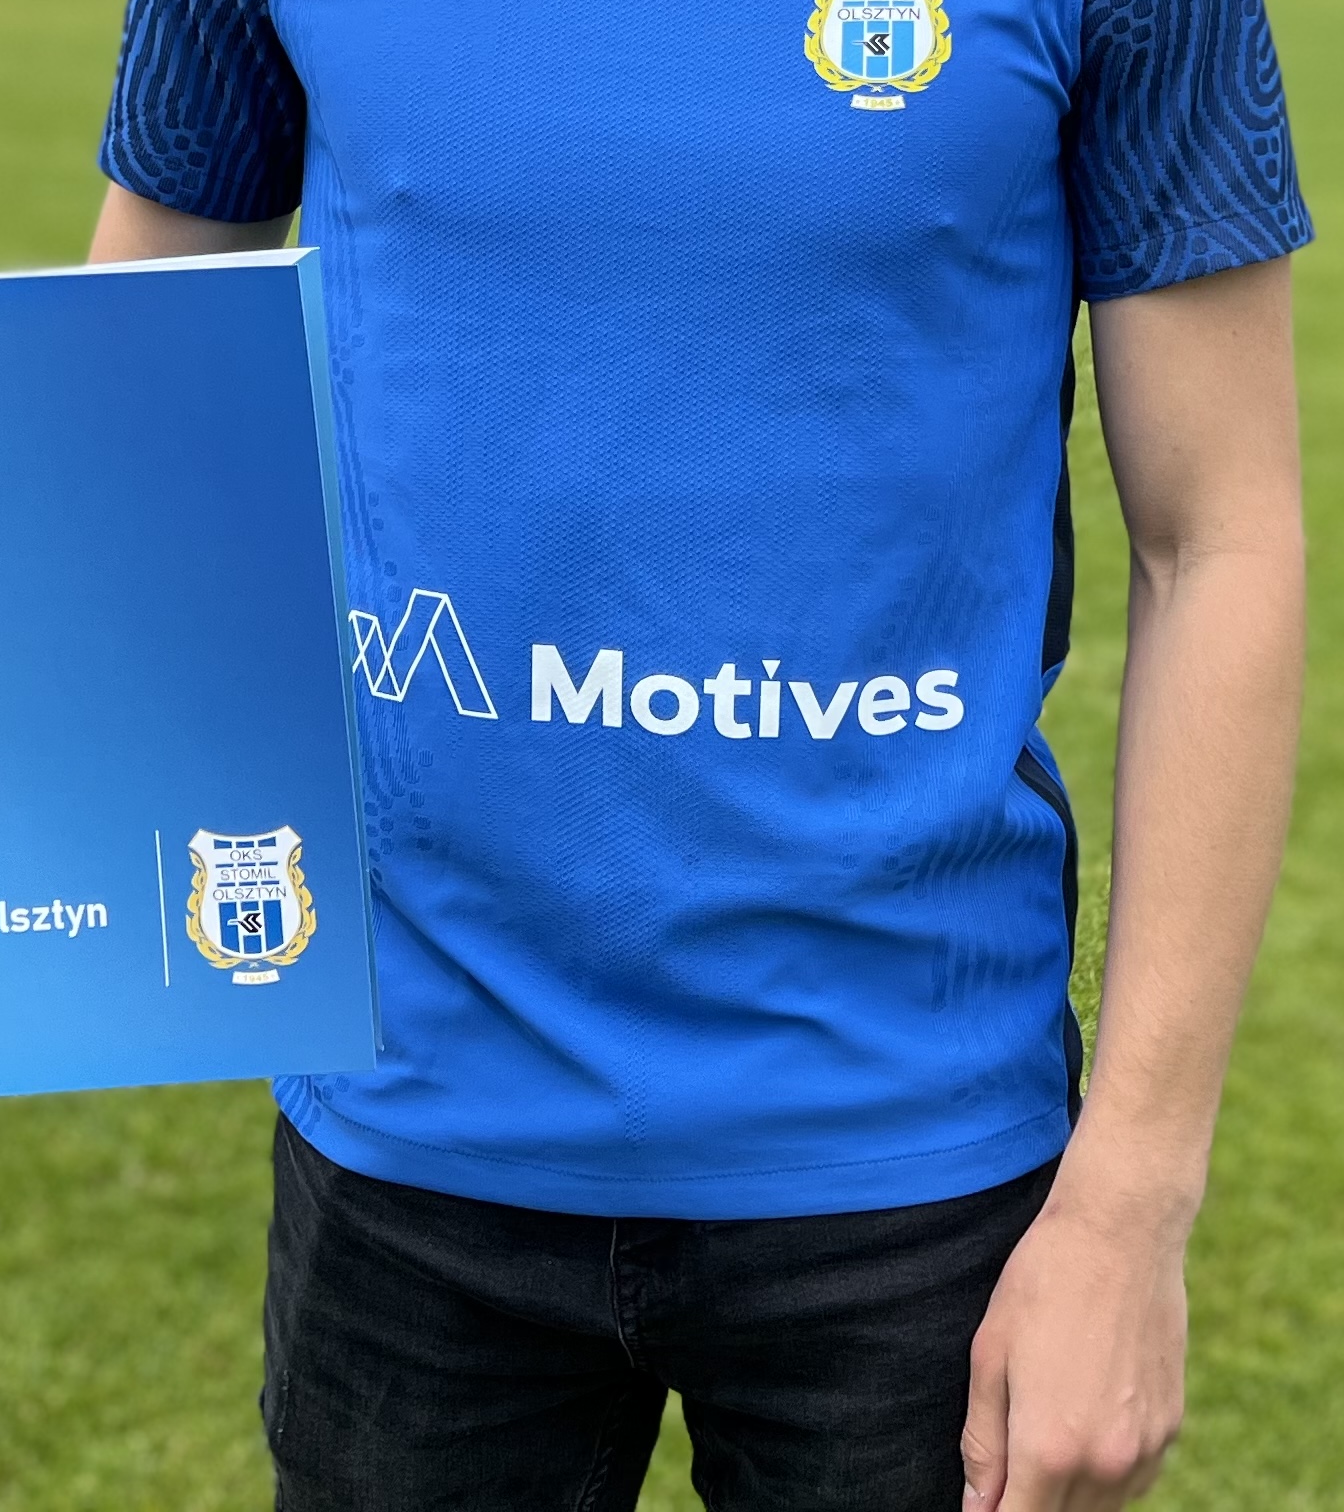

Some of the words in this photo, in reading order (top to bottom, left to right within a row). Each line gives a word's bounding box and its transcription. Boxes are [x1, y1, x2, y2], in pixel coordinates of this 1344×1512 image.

[837, 8, 921, 20] OLSZTYN
[531, 644, 965, 739] Motives
[230, 849, 263, 861] OKS
[220, 868, 276, 881] STOMIL
[212, 886, 287, 901] OLSZTYN
